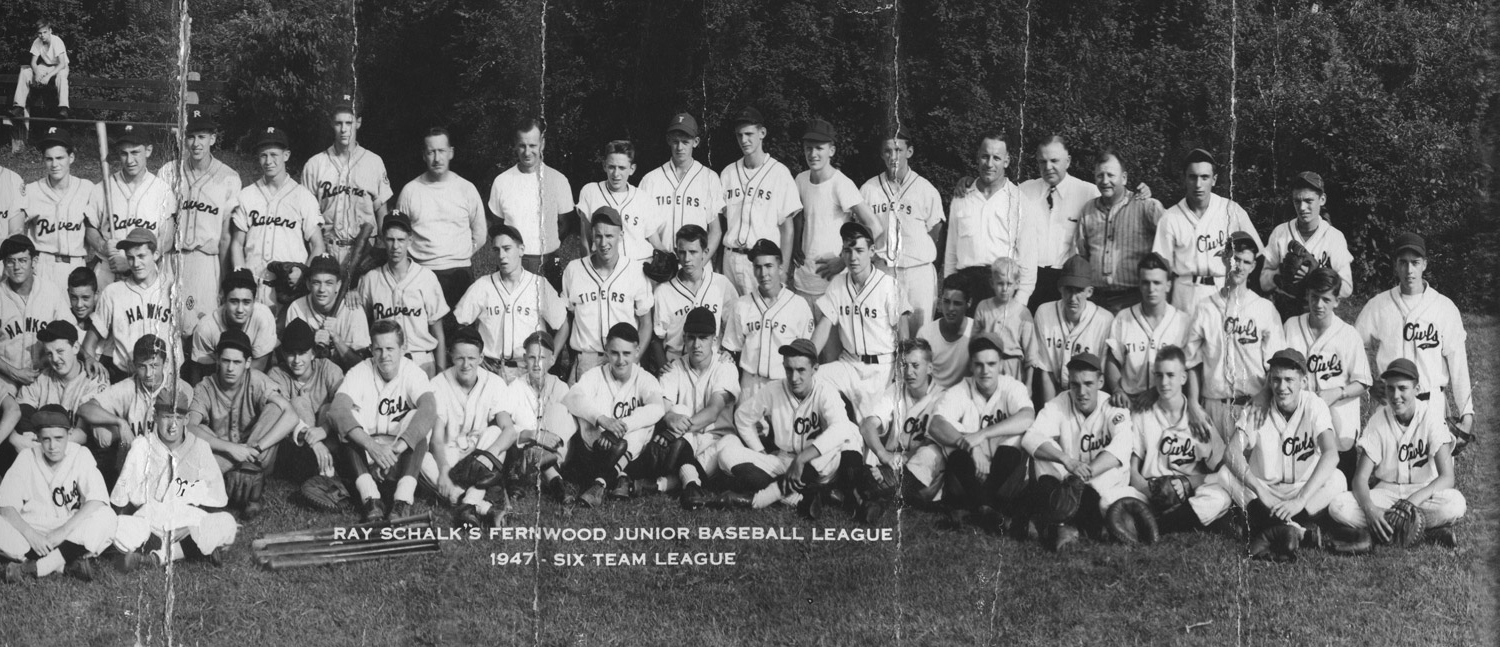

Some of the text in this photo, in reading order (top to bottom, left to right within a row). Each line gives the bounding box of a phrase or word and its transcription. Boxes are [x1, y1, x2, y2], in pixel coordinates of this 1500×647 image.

[267, 126, 275, 134] R
[656, 195, 699, 207] TIGERS
[727, 187, 771, 200] TIGERS
[182, 200, 218, 215] avens
[248, 210, 296, 229] Ravens
[578, 290, 625, 304] TIGERS
[126, 302, 171, 324] HAWKS
[373, 302, 421, 320] Ravens
[746, 318, 787, 335] TIGERS
[1223, 316, 1258, 338] Owls
[1403, 322, 1439, 343] Owls
[1307, 353, 1342, 374] Owls
[1080, 431, 1112, 453] Owls
[1160, 436, 1195, 459] Owls
[1282, 431, 1315, 456] Owls
[1398, 439, 1429, 462] Owls
